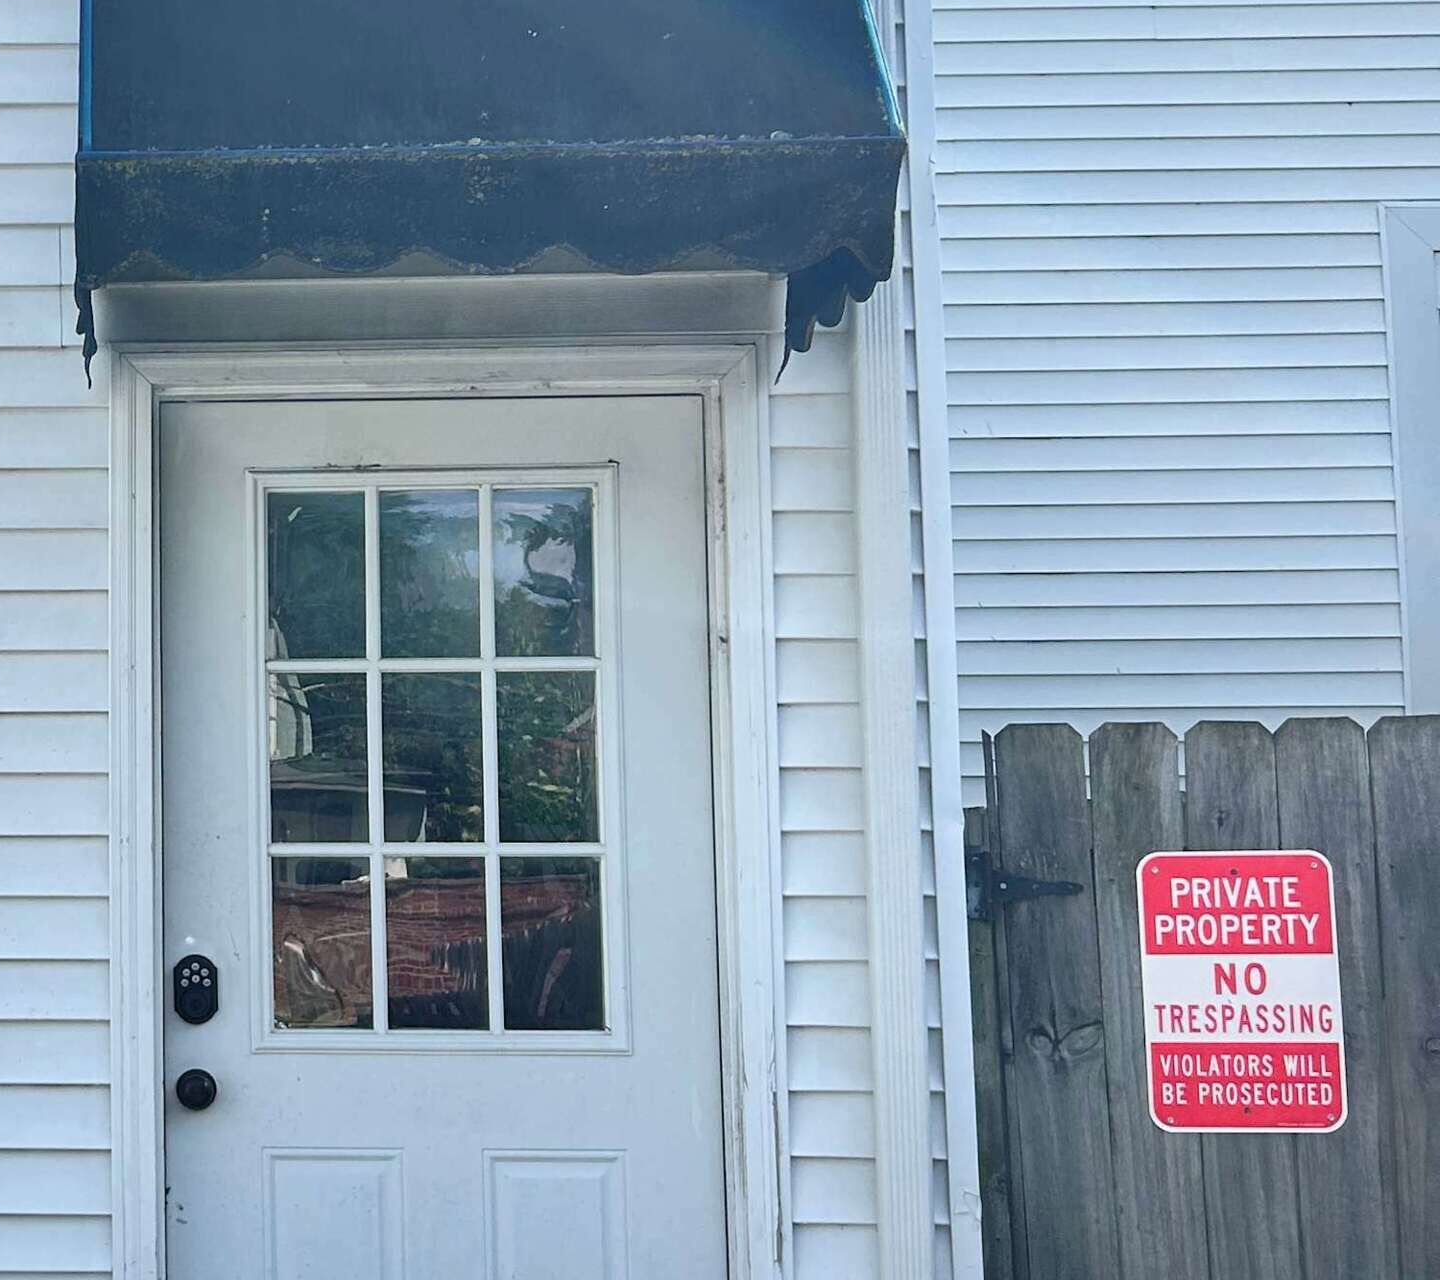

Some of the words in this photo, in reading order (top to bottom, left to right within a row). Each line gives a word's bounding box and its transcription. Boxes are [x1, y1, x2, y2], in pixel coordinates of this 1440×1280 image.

[1170, 876, 1302, 909] PRIVATE
[1154, 913, 1320, 946] PROPERTY
[1213, 962, 1267, 996] NO
[1154, 1004, 1333, 1033] TRESPASSING
[1159, 1054, 1274, 1077] VIOLATORS
[1283, 1054, 1333, 1077] WILL
[1161, 1082, 1187, 1105] BE
[1198, 1082, 1333, 1106] PROSECUTED
